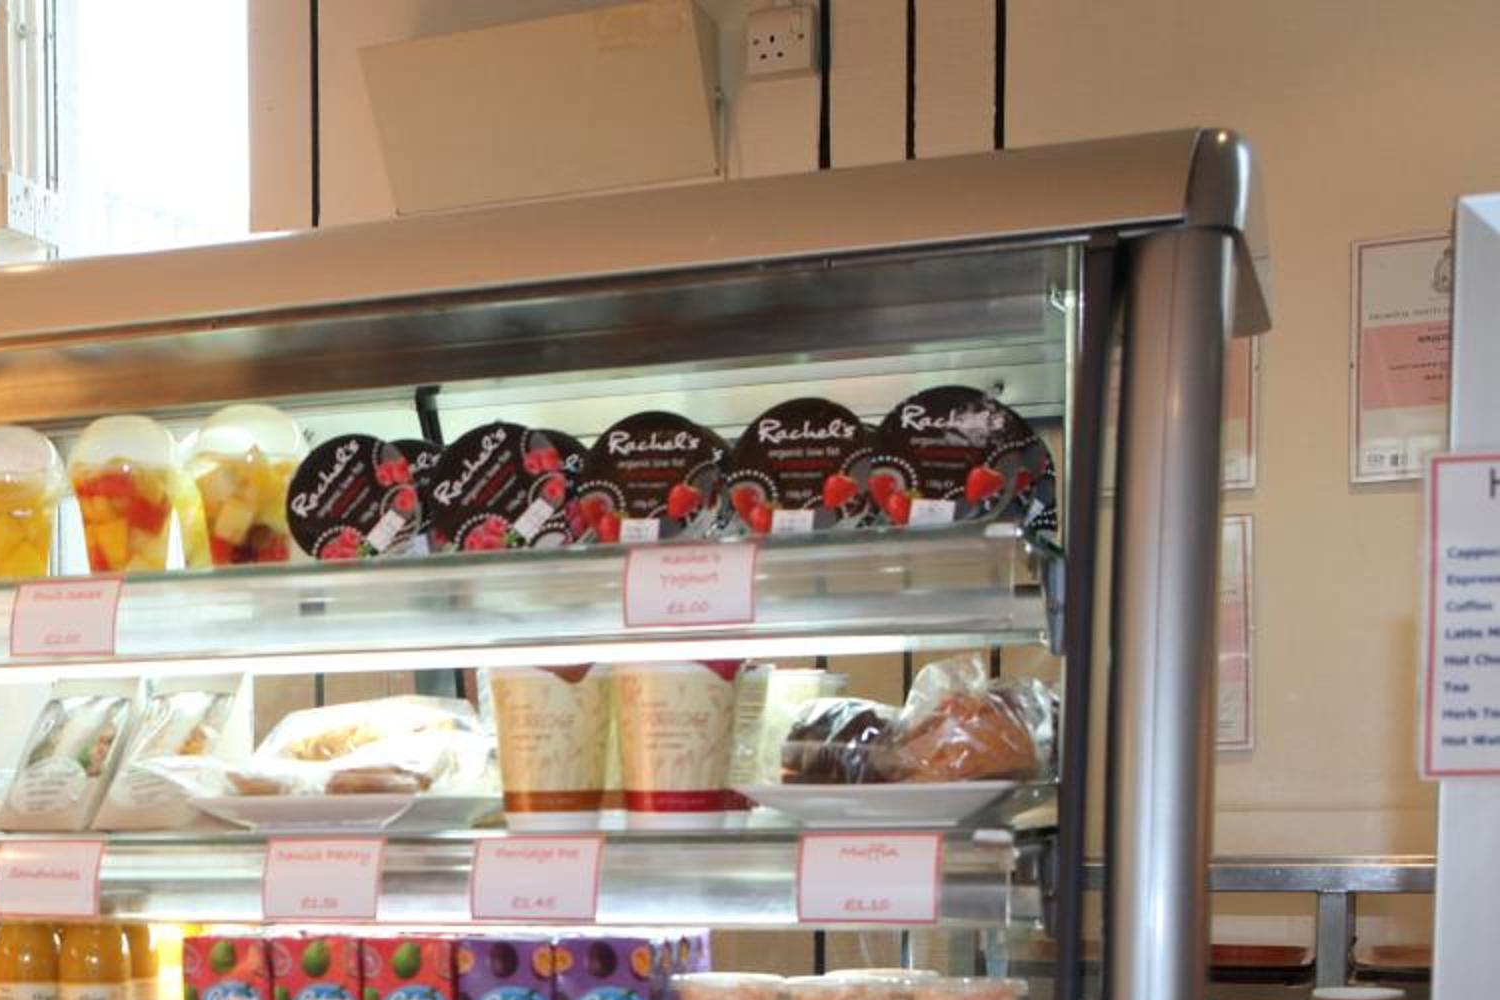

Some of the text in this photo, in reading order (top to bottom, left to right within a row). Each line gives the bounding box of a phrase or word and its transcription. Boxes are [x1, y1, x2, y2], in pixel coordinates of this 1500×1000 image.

[607, 430, 700, 455] Rachel's
[758, 418, 855, 444] Rachel's
[290, 439, 360, 518] Rachel's
[432, 428, 507, 506] Rachel's
